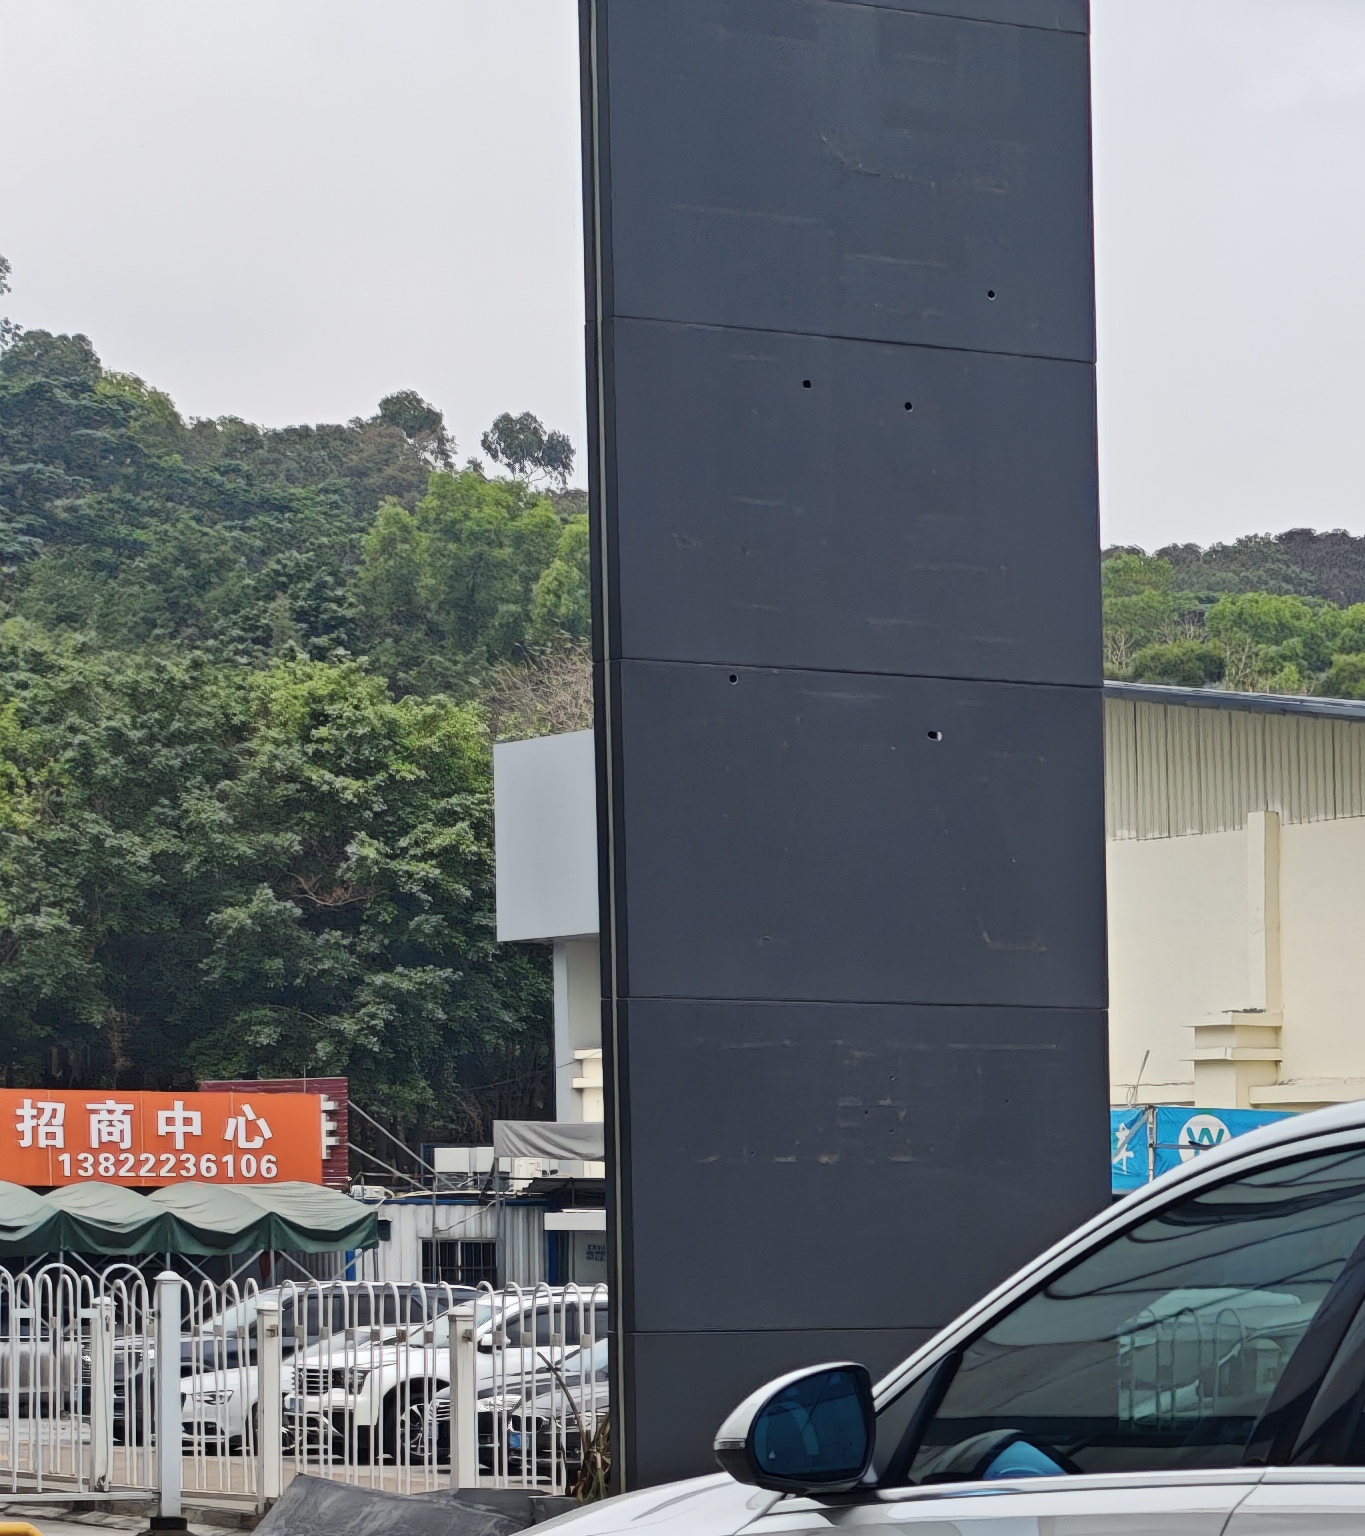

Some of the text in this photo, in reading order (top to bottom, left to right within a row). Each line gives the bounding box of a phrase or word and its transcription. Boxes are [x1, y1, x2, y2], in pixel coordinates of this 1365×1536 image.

[15, 1098, 273, 1150] 招商中心
[58, 1152, 278, 1178] 13822236106
